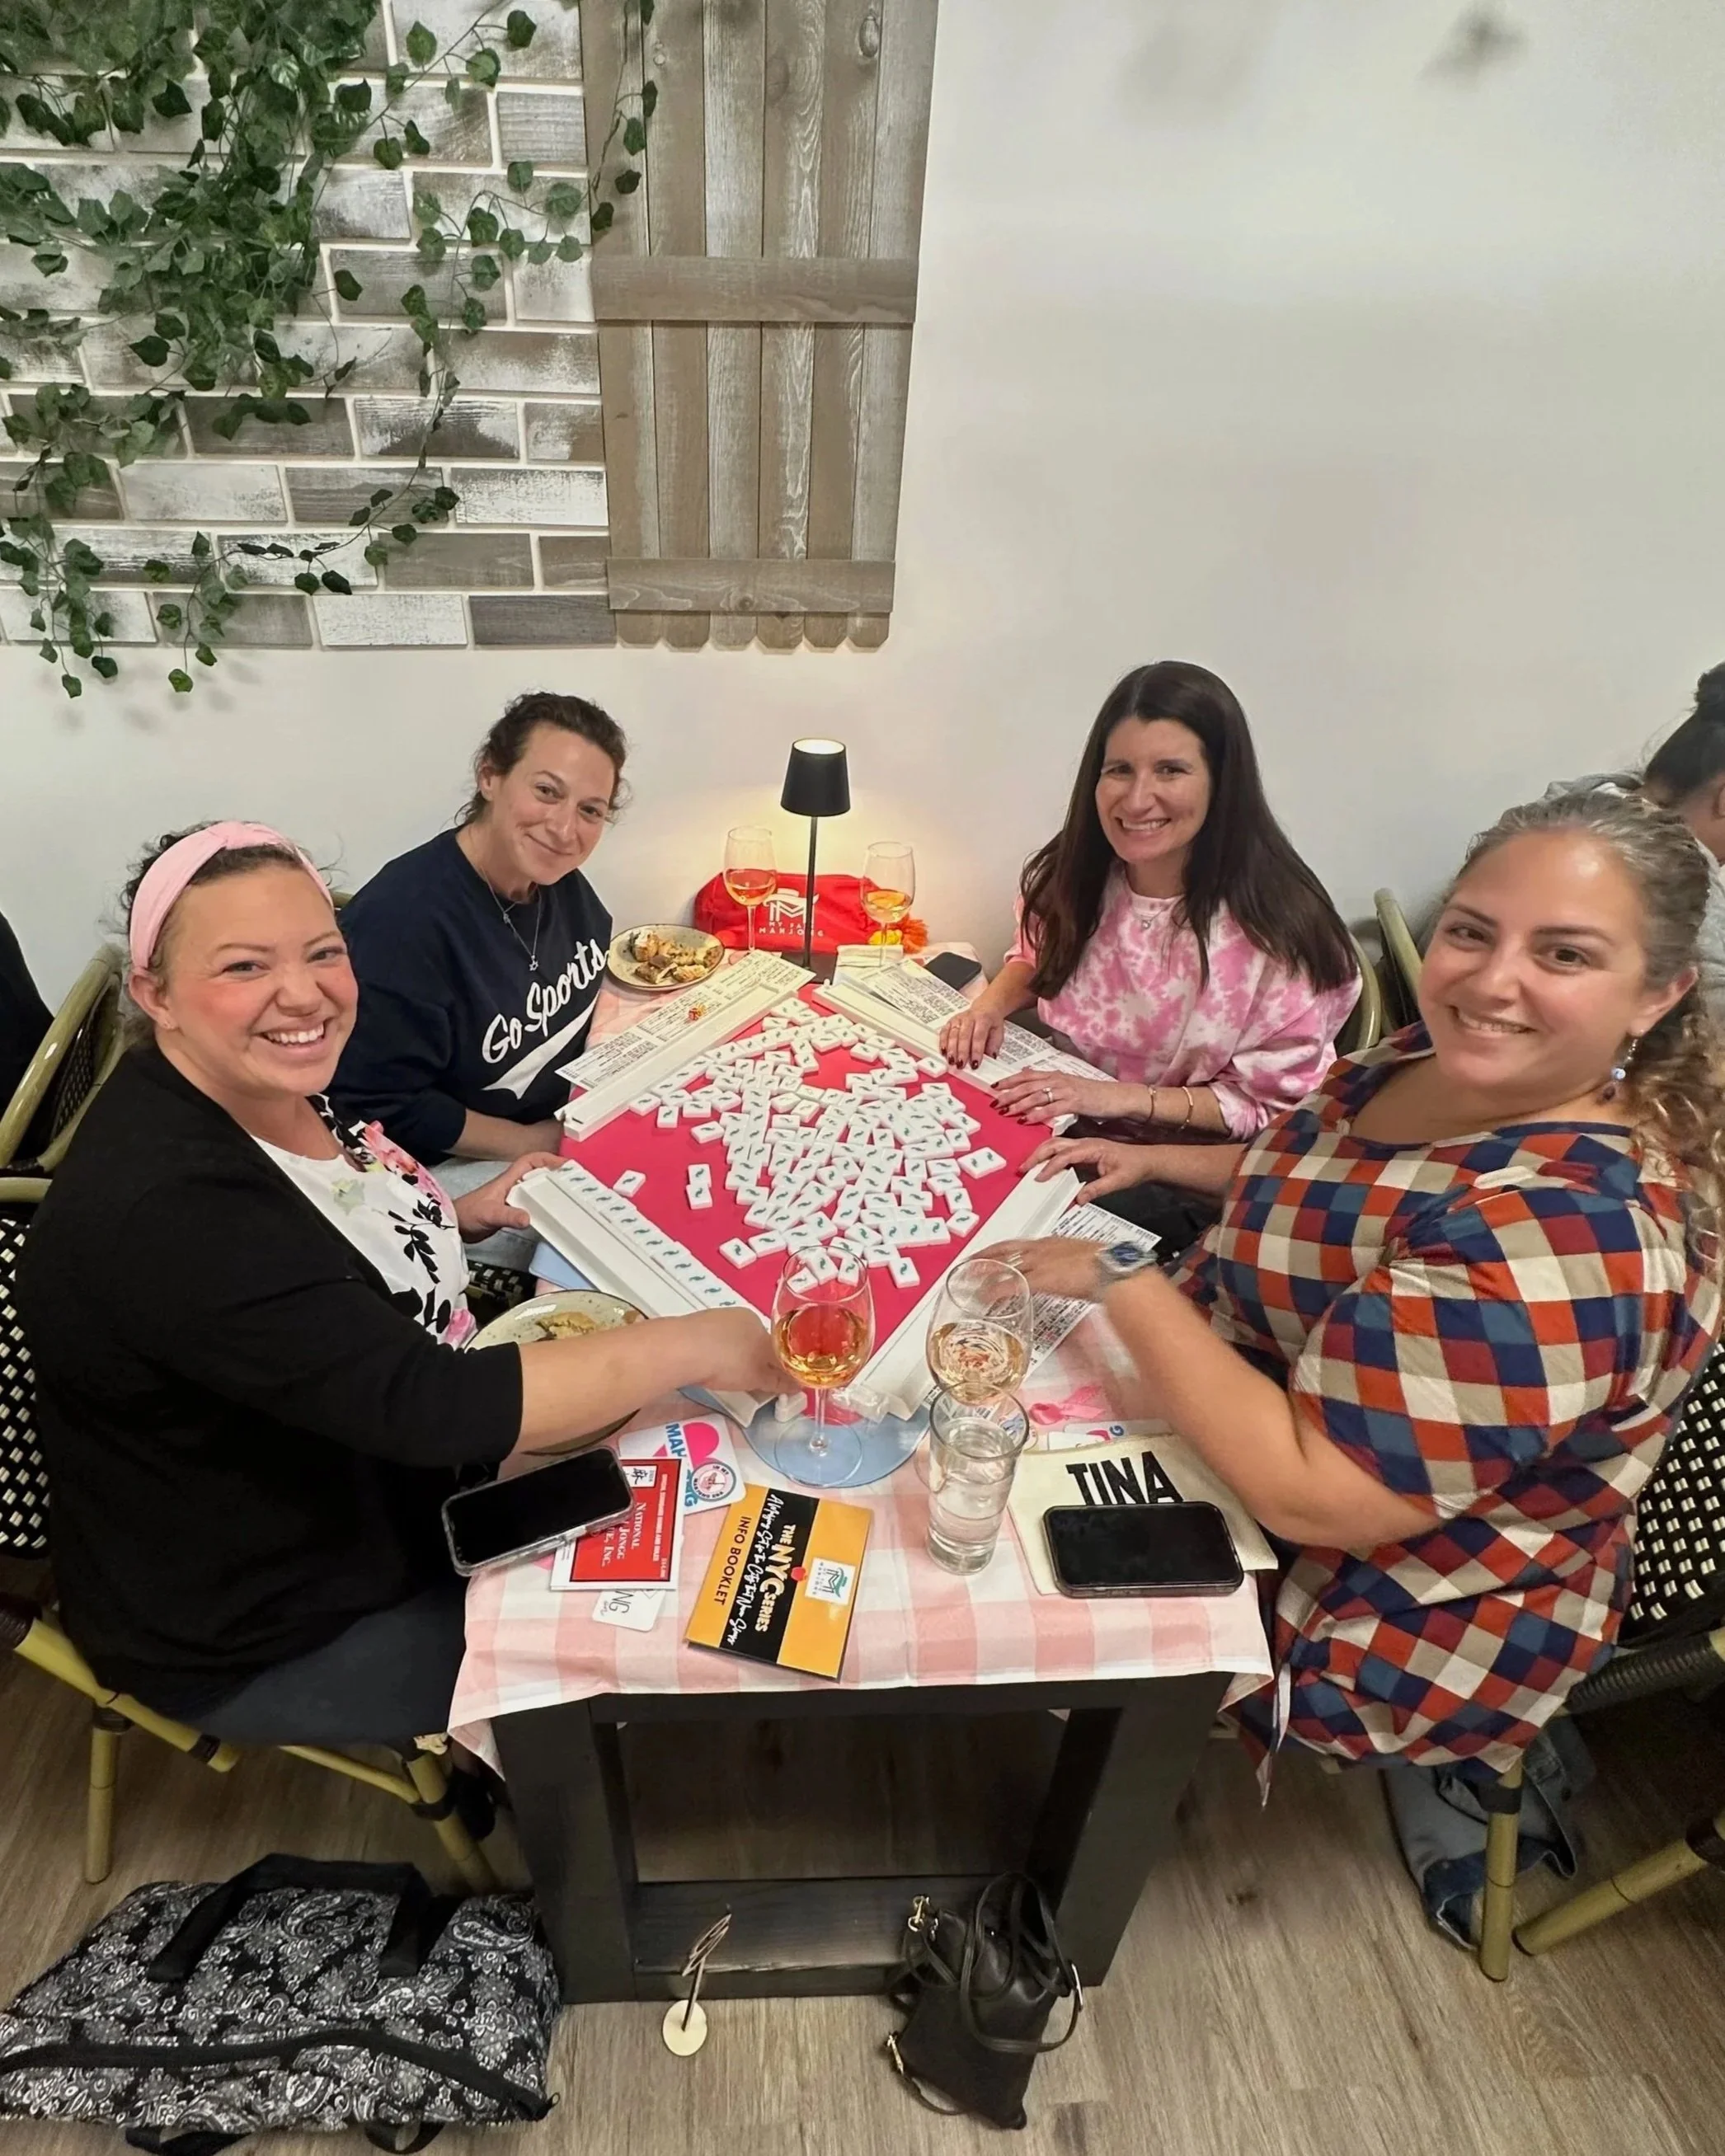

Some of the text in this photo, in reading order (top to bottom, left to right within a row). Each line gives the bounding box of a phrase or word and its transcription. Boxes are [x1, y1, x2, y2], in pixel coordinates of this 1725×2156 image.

[482, 1013, 522, 1064] Go
[524, 938, 609, 1037] Sports
[1065, 1450, 1184, 1505] TINA
[617, 1526, 631, 1560] JONGG
[631, 1502, 646, 1550] NATIONAL
[601, 1546, 614, 1567] INC.
[714, 1515, 752, 1606] INFO BOOKLET
[744, 1563, 764, 1583] City
[754, 1524, 797, 1632] THE NYC SERIES
